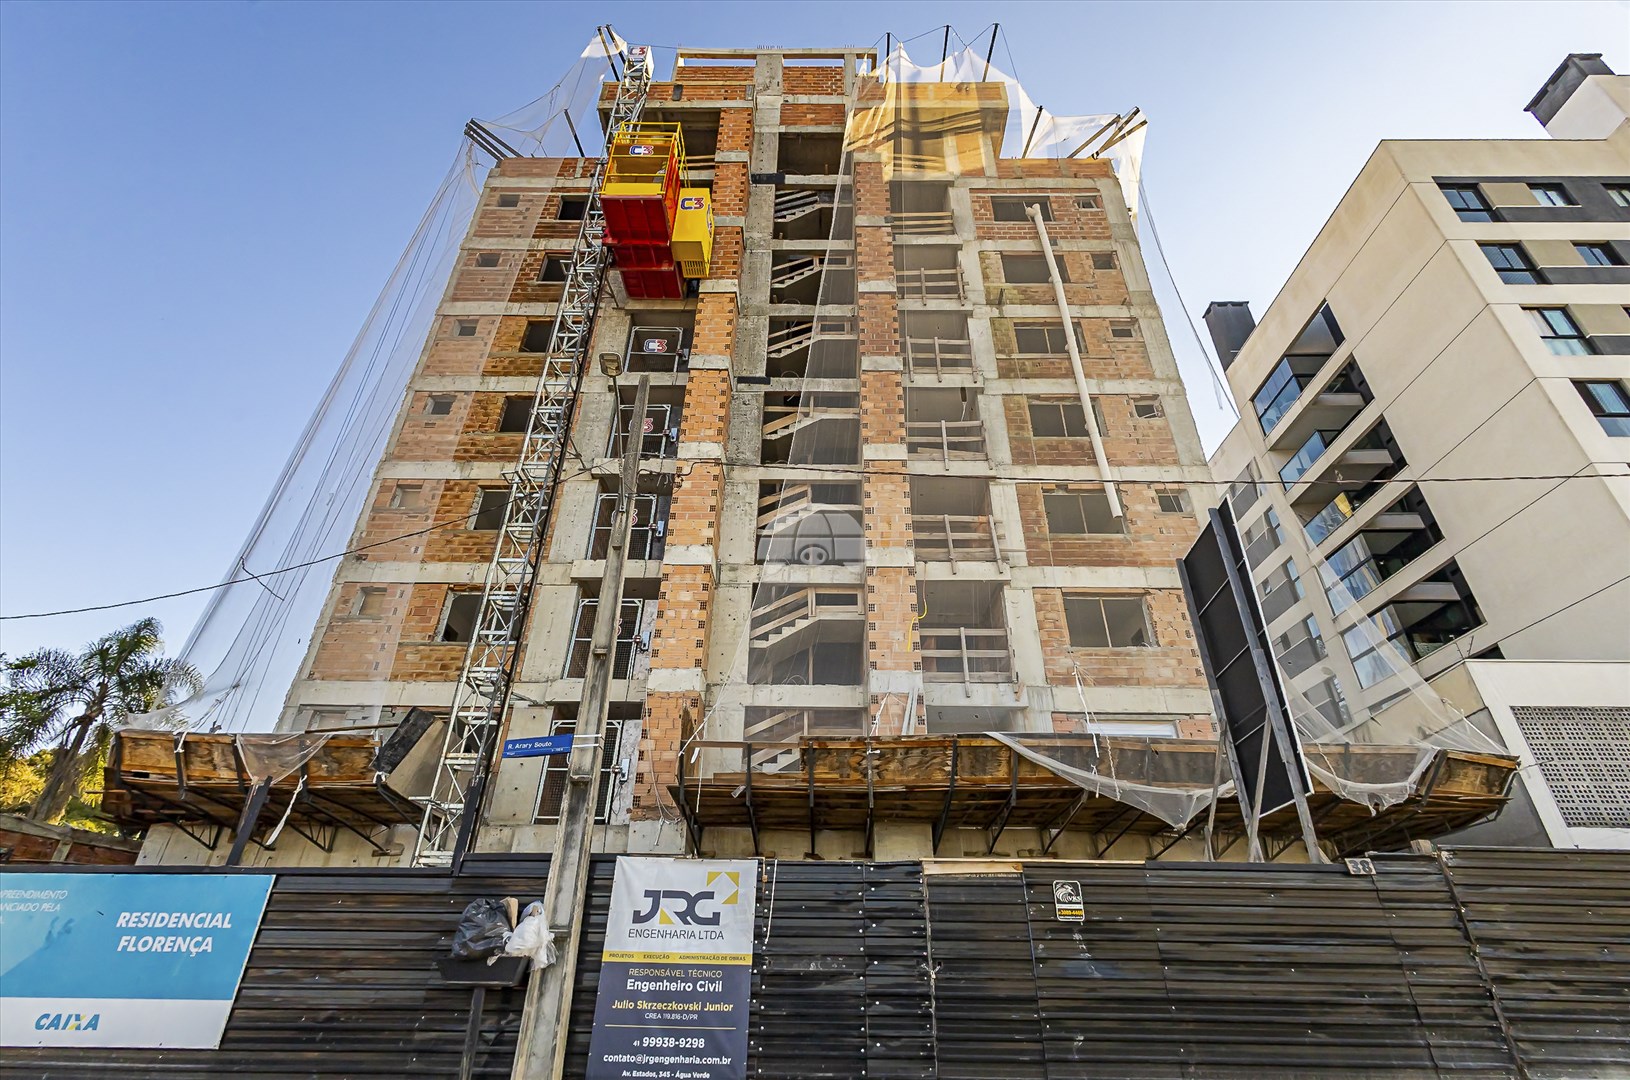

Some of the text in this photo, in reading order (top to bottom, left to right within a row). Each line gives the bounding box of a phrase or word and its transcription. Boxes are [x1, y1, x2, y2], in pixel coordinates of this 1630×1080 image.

[629, 46, 646, 56] C3
[629, 145, 654, 156] C3
[680, 197, 705, 210] C3
[644, 339, 667, 352] C3
[1348, 860, 1372, 874] 38
[40, 902, 61, 912] PELA
[631, 889, 722, 926] JRG
[116, 911, 232, 929] RESIDENCIAL
[628, 928, 725, 941] ENGENHARIA LTDA
[117, 936, 213, 957] FLORENÇA
[628, 968, 723, 978] RESPONSÁVEL TÉCNICO
[626, 979, 723, 992] Engenheiro Civil
[612, 1000, 734, 1012] Julio Skrzeczkovski Junior
[34, 1013, 100, 1031] CAIXA
[644, 1012, 662, 1020] CREA
[642, 1036, 705, 1049] 99938-9298
[603, 1053, 732, 1065] contato@jrgengenharia.com.br
[632, 1070, 658, 1078] Estados,
[675, 1070, 692, 1079] Água
[692, 1071, 711, 1079] Verde
